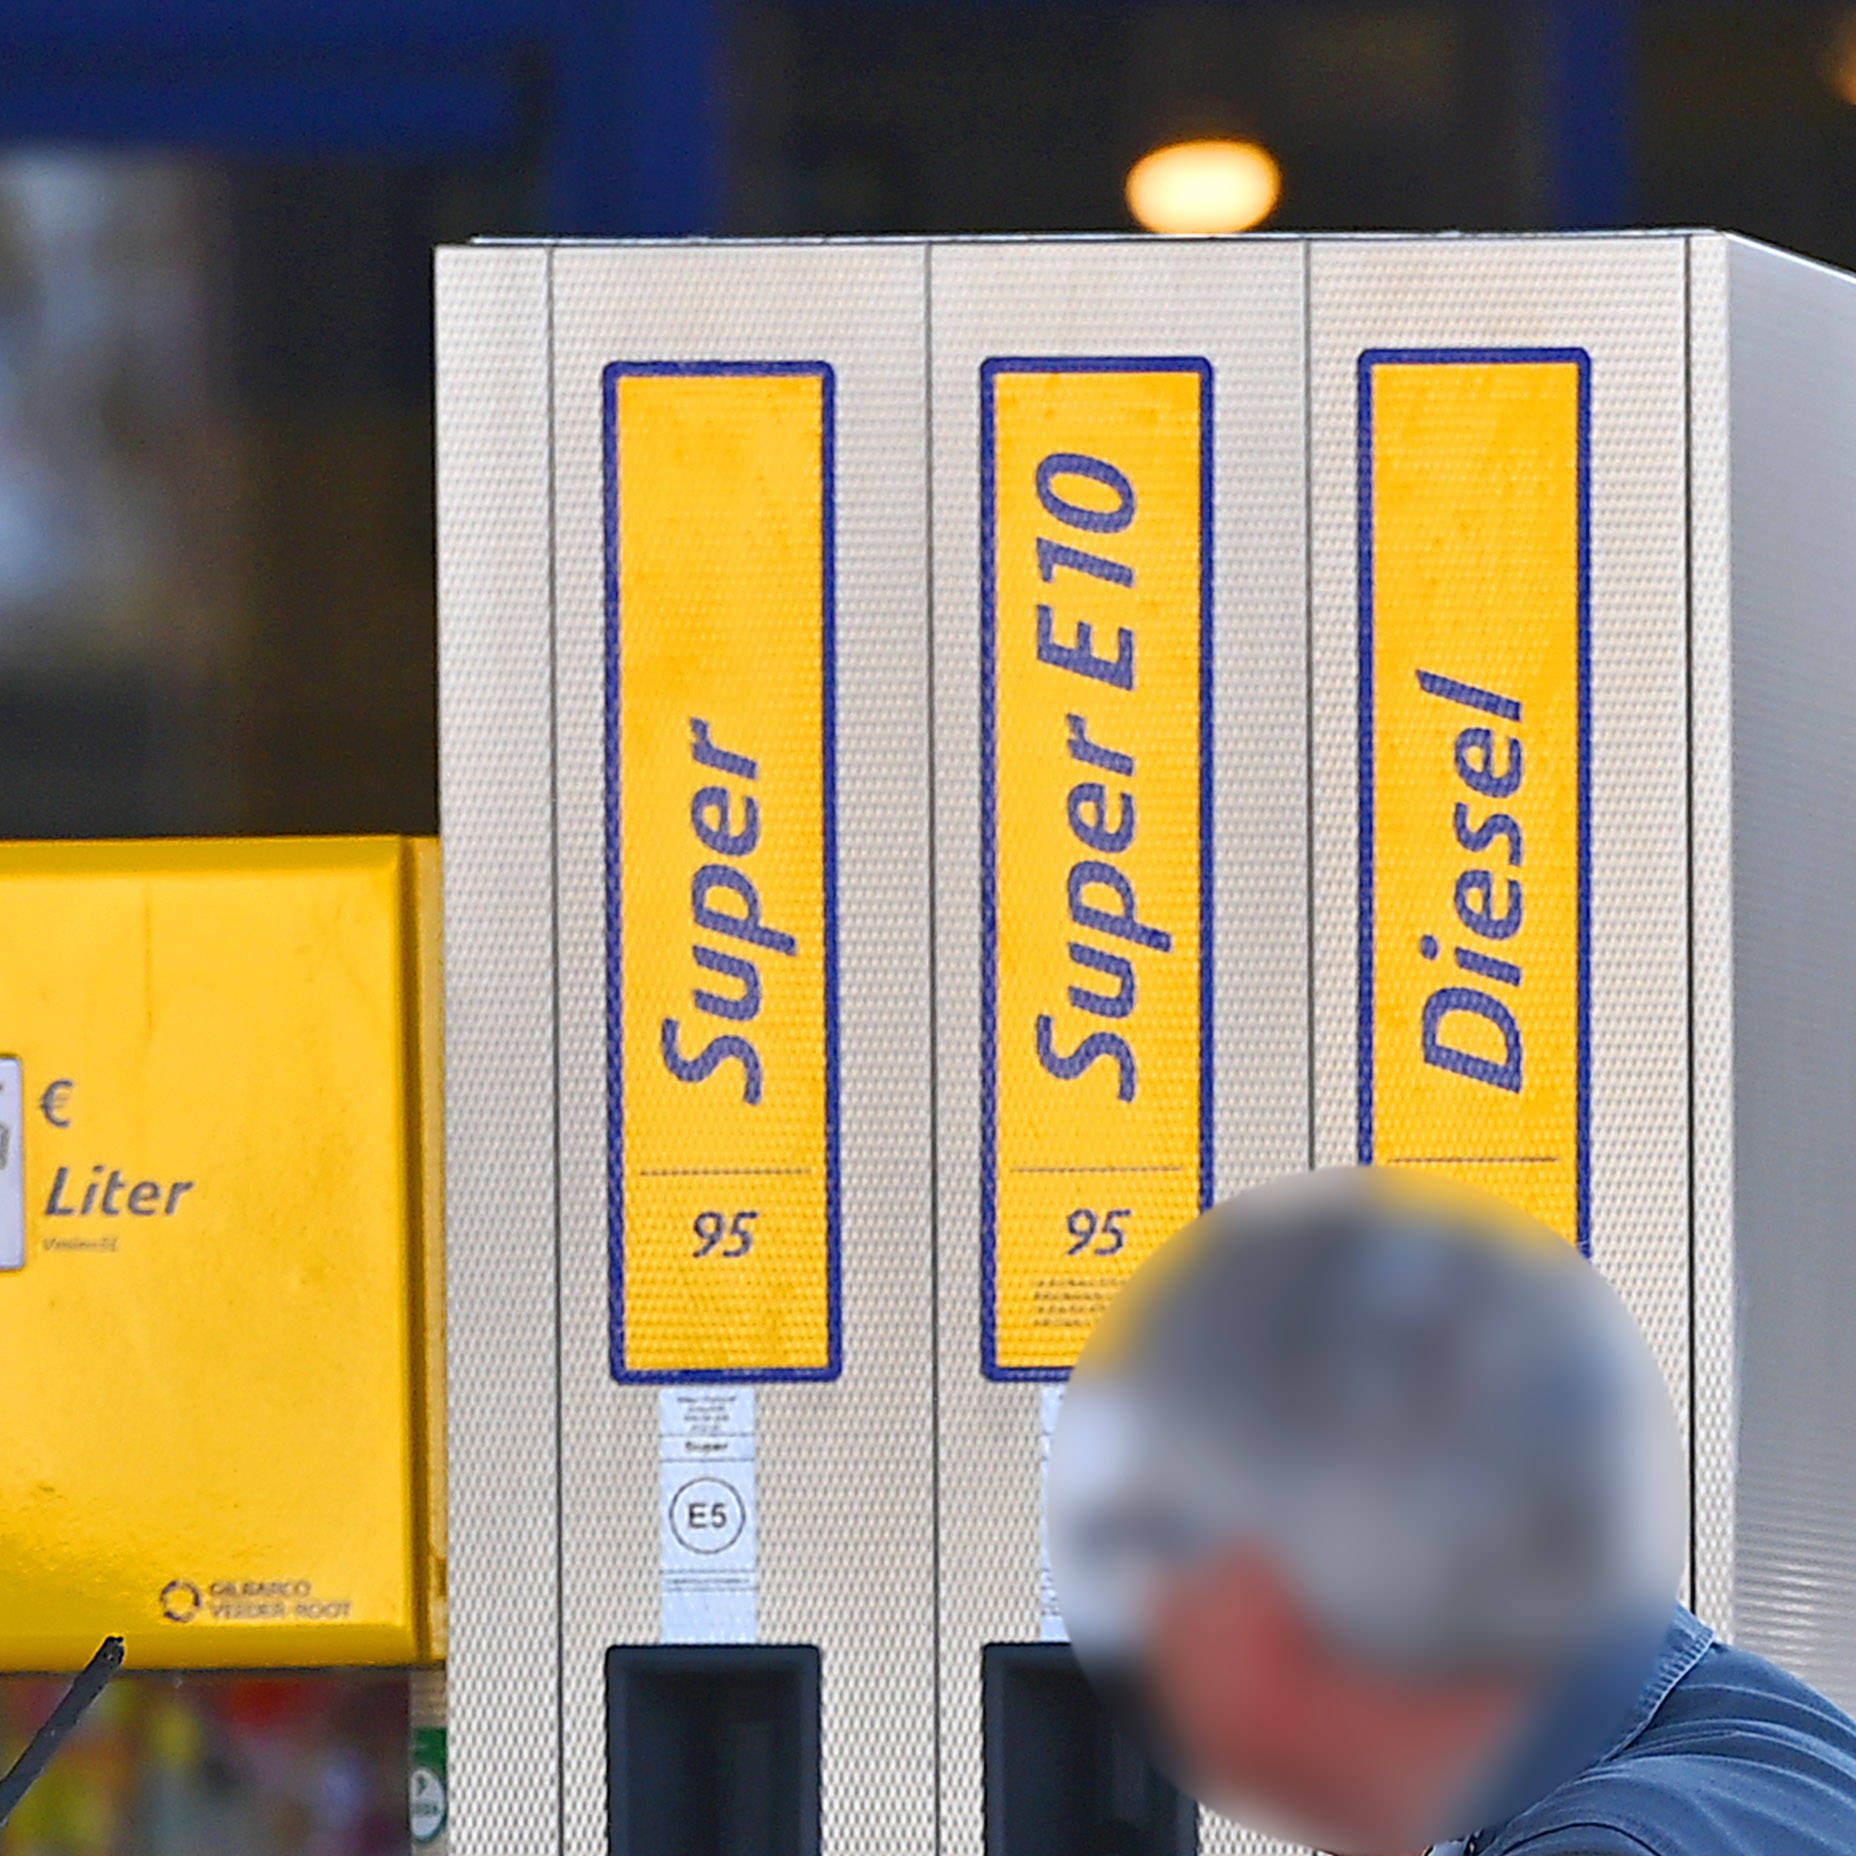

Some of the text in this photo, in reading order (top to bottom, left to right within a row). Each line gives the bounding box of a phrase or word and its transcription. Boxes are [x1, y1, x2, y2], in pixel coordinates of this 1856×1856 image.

[1035, 450, 1173, 1104] Super E10
[1415, 668, 1526, 1096] Diesel
[661, 716, 798, 1106] Super
[39, 1078, 74, 1129] €
[44, 1163, 195, 1217] Liter
[694, 1210, 760, 1259] 95
[1066, 1207, 1133, 1257] 95
[687, 1502, 728, 1529] E5
